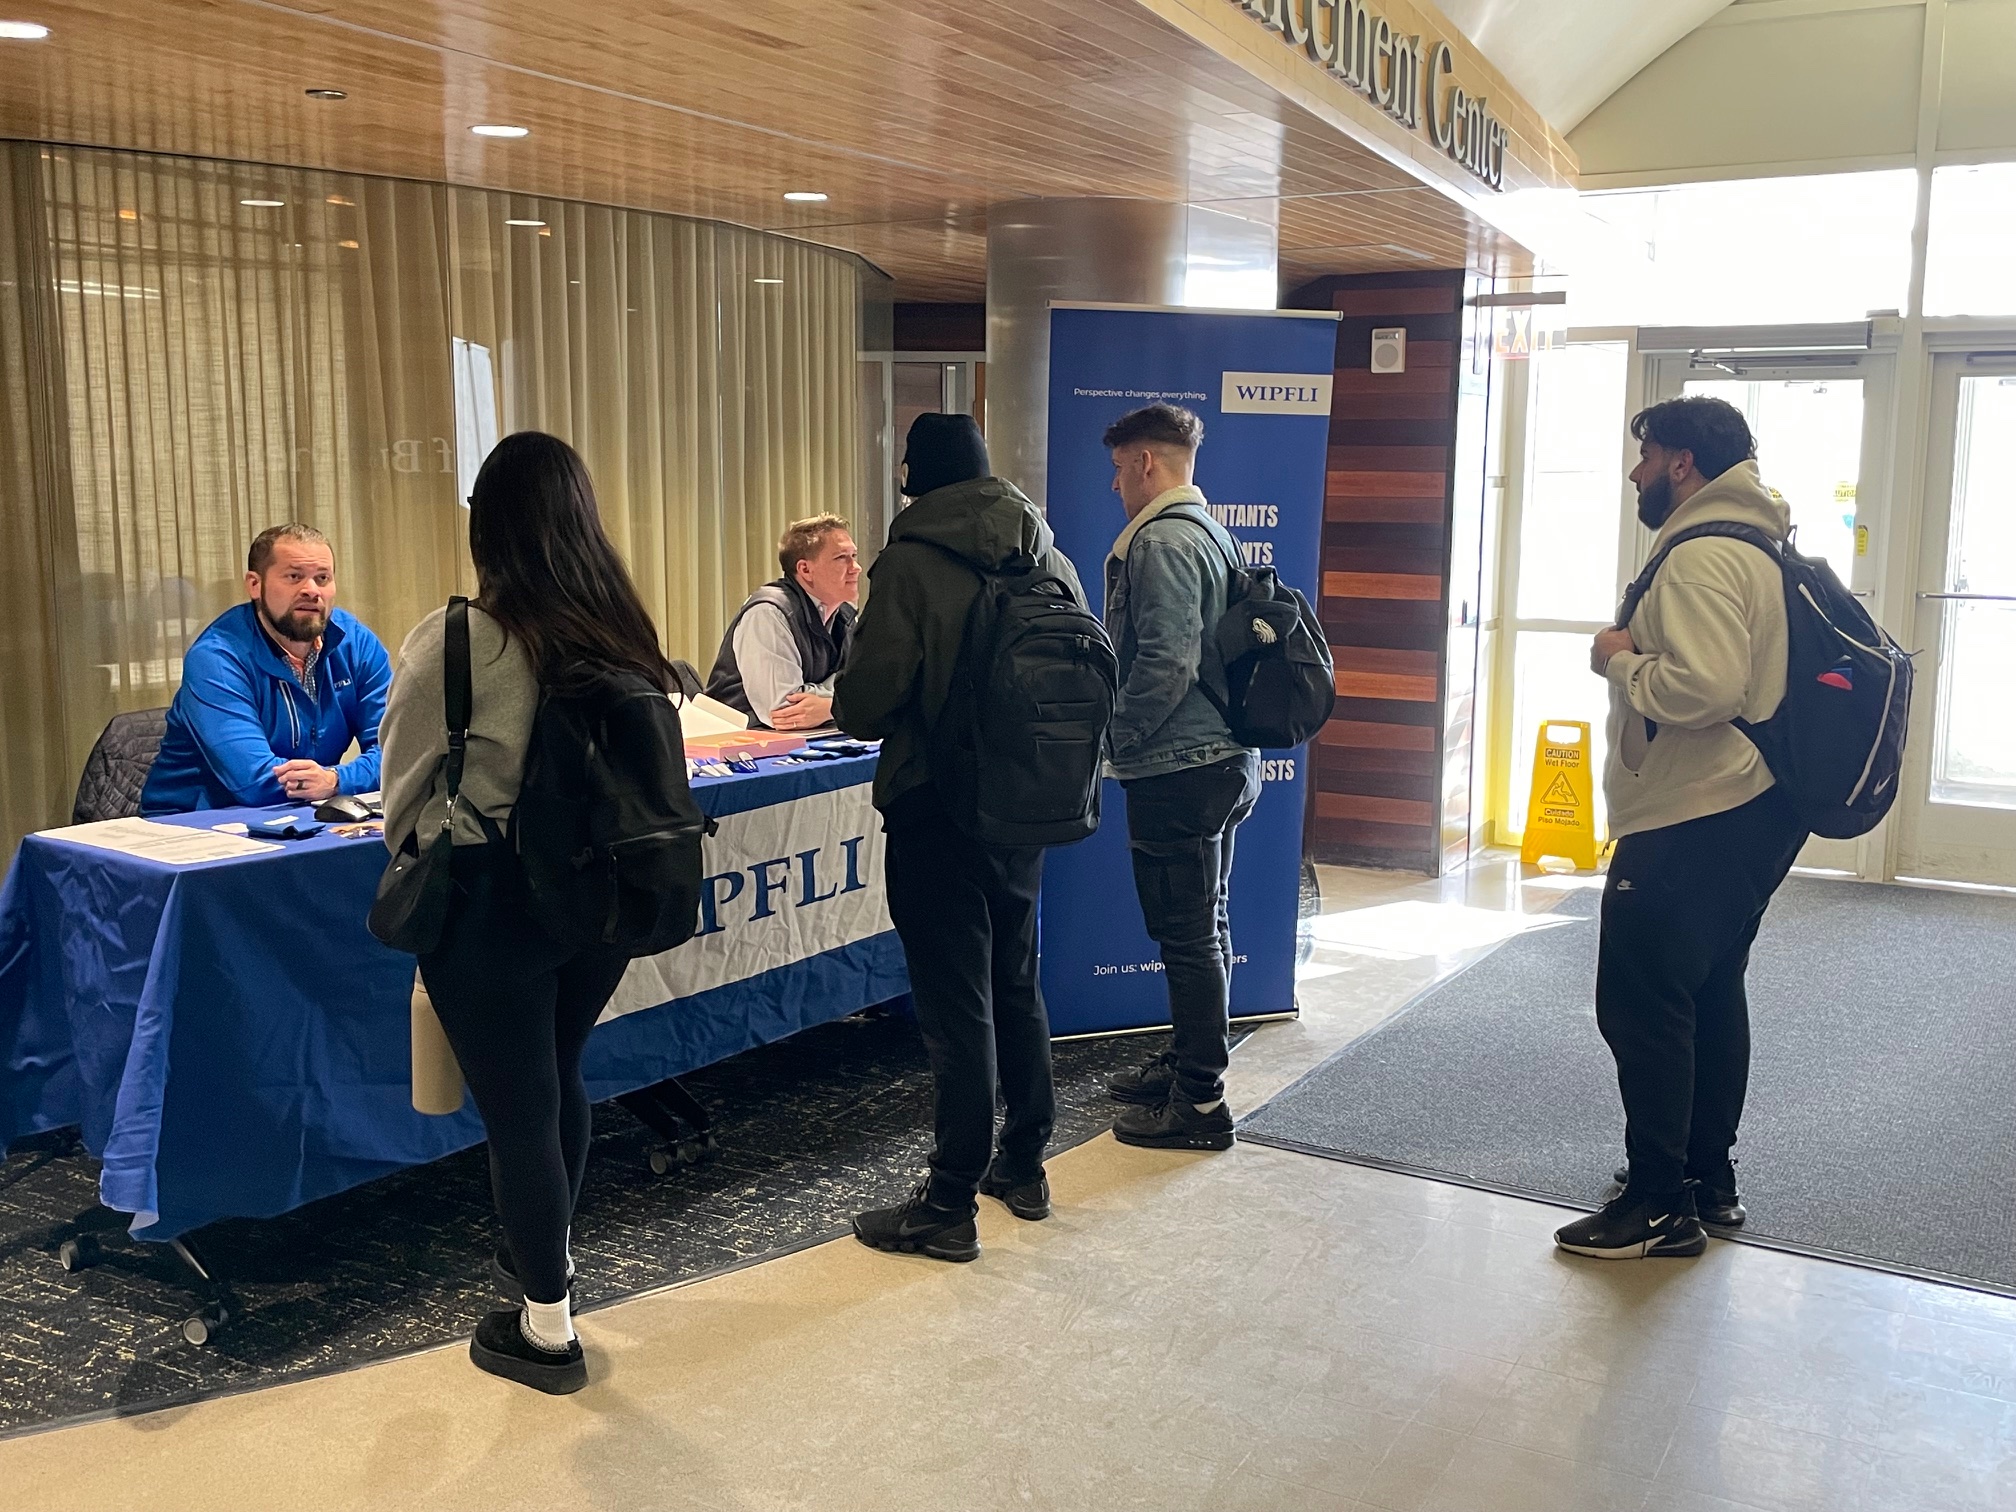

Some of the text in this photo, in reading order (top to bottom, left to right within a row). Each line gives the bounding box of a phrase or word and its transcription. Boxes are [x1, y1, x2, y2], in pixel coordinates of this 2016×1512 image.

[1427, 40, 1509, 193] Center
[1074, 387, 1123, 398] Perspective
[1161, 390, 1207, 401] everything.
[1235, 384, 1319, 402] WIPFLI
[1546, 749, 1579, 759] CAUTION
[1261, 759, 1295, 781] ISTS
[1545, 758, 1579, 768] Wet Floor
[1093, 963, 1117, 976] Join
[1121, 963, 1137, 973] us:
